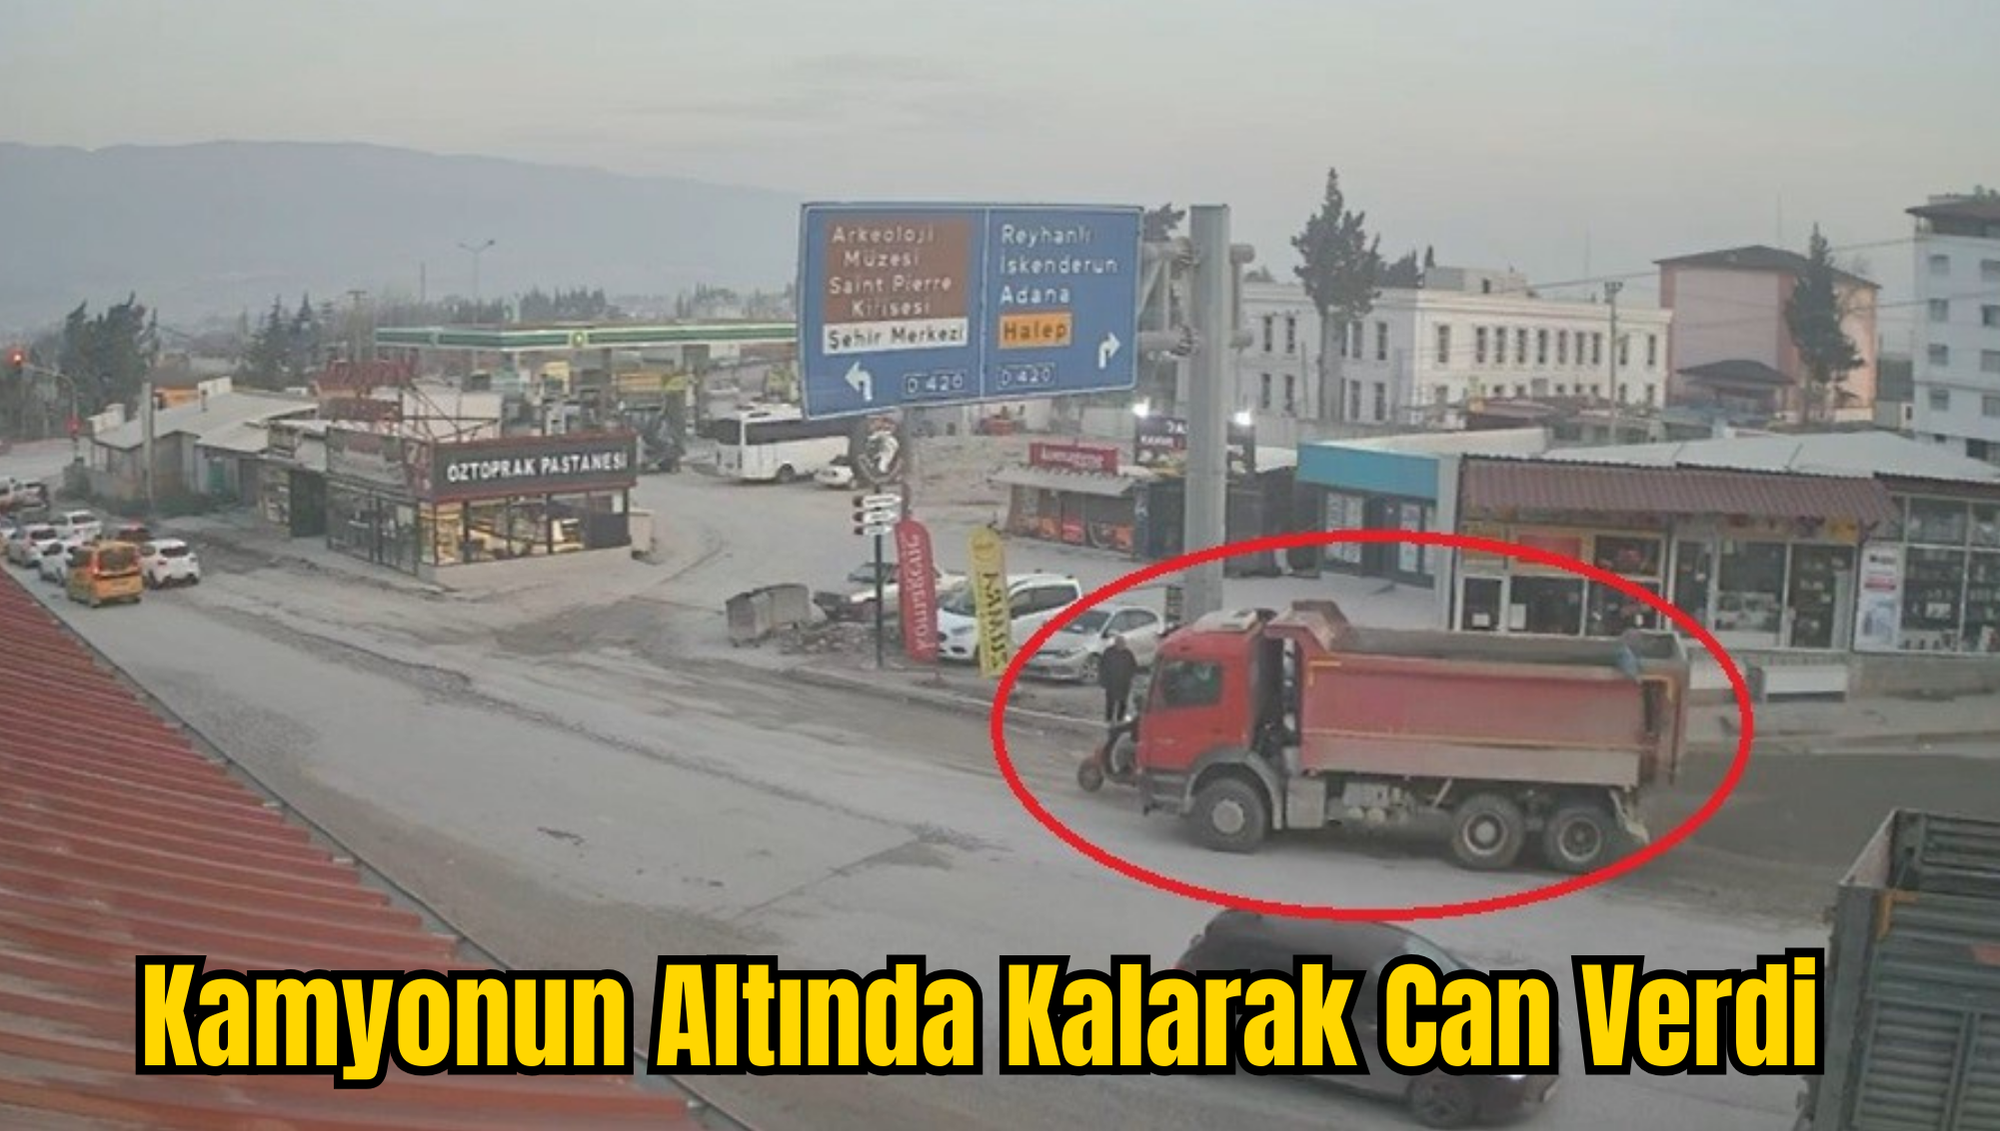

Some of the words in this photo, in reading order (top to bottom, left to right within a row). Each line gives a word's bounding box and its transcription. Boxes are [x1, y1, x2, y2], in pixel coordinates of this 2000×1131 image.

[831, 225, 934, 245] Arkeoloji
[843, 248, 919, 268] Müzesi
[828, 276, 884, 295] Saint
[891, 273, 953, 292] Pierre
[1000, 284, 1071, 304] Adana
[891, 325, 964, 344] Merkezi
[1003, 319, 1069, 341] Halep
[925, 374, 964, 392] 420
[1017, 367, 1051, 382] 420
